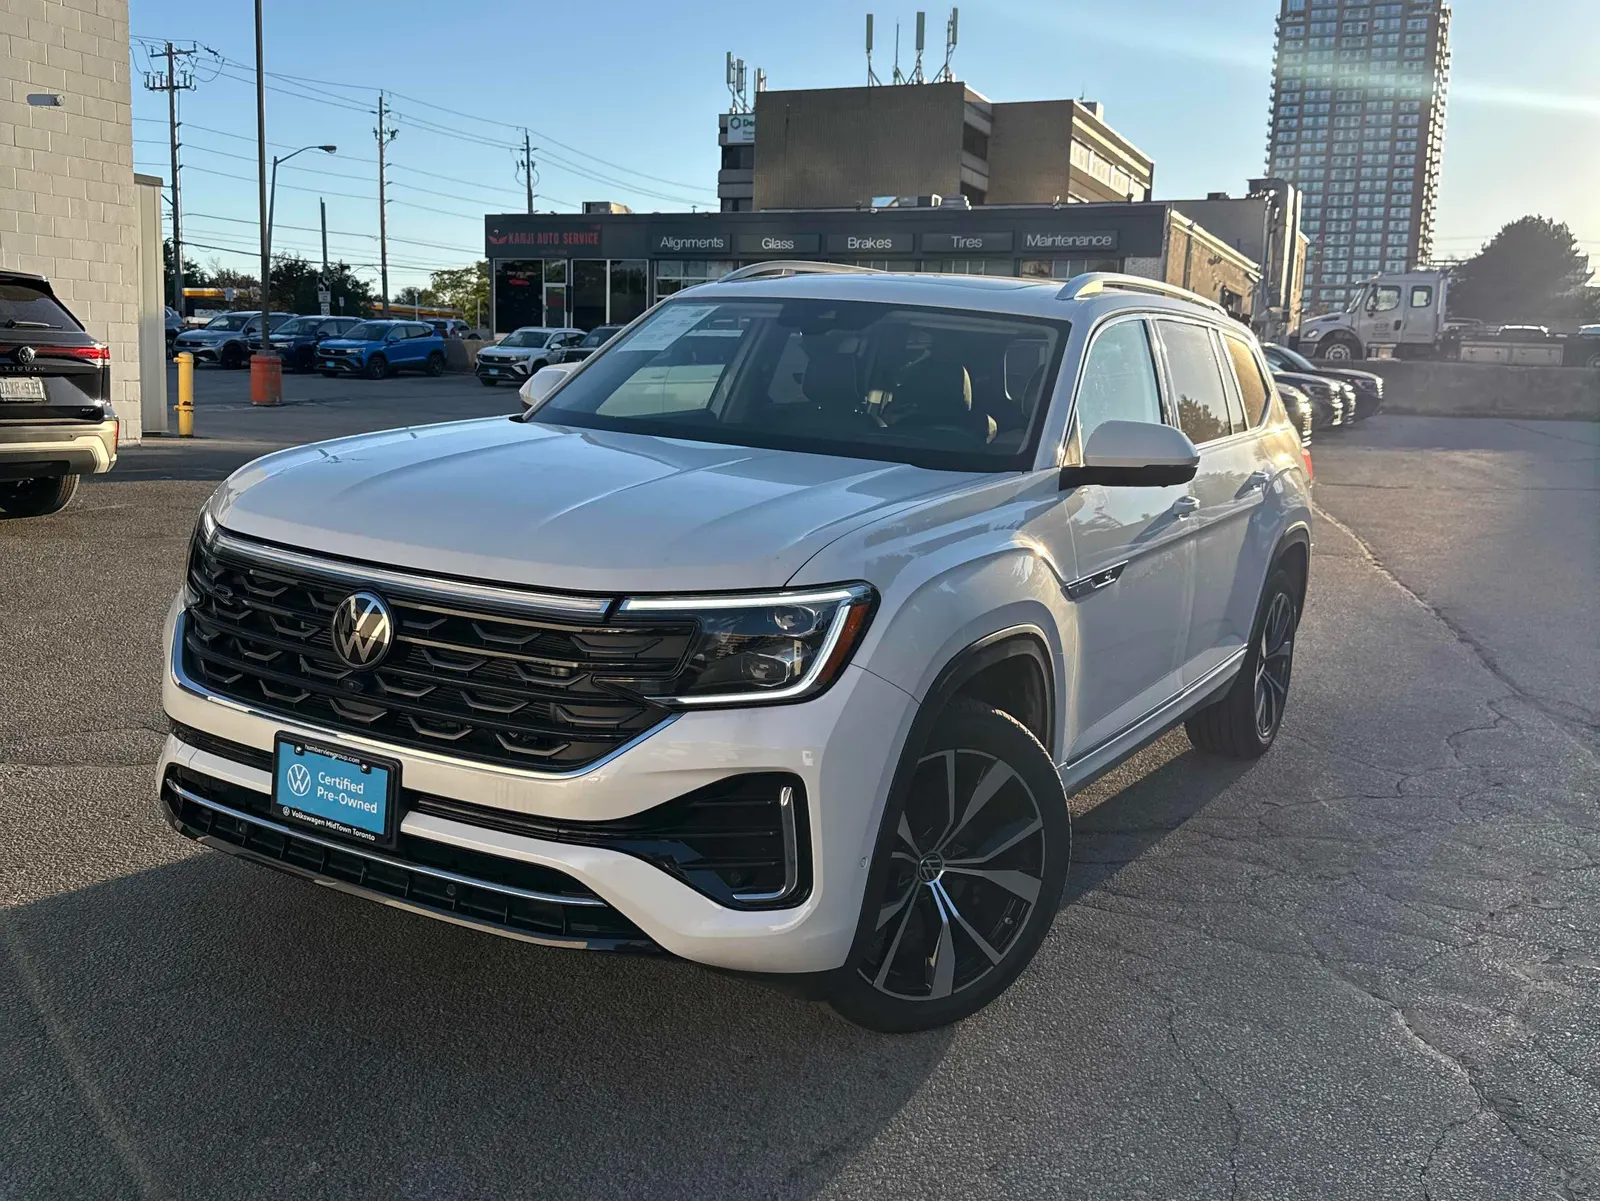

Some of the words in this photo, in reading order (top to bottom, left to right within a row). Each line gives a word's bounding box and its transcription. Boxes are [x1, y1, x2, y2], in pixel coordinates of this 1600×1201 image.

[537, 232, 560, 245] AUTO
[563, 232, 599, 245] SERVICE
[660, 236, 724, 251] Alignments
[761, 237, 794, 250] Glass
[847, 236, 892, 250] Brakes
[951, 235, 983, 248] Tires
[1026, 233, 1112, 247] Maintenance
[305, 743, 360, 764] humberviewgroup.com
[318, 772, 364, 795] Certified
[317, 787, 378, 814] Pre-Owned
[291, 809, 325, 827] Volkswagen
[325, 820, 352, 834] MidTown
[352, 828, 376, 841] Toronto
